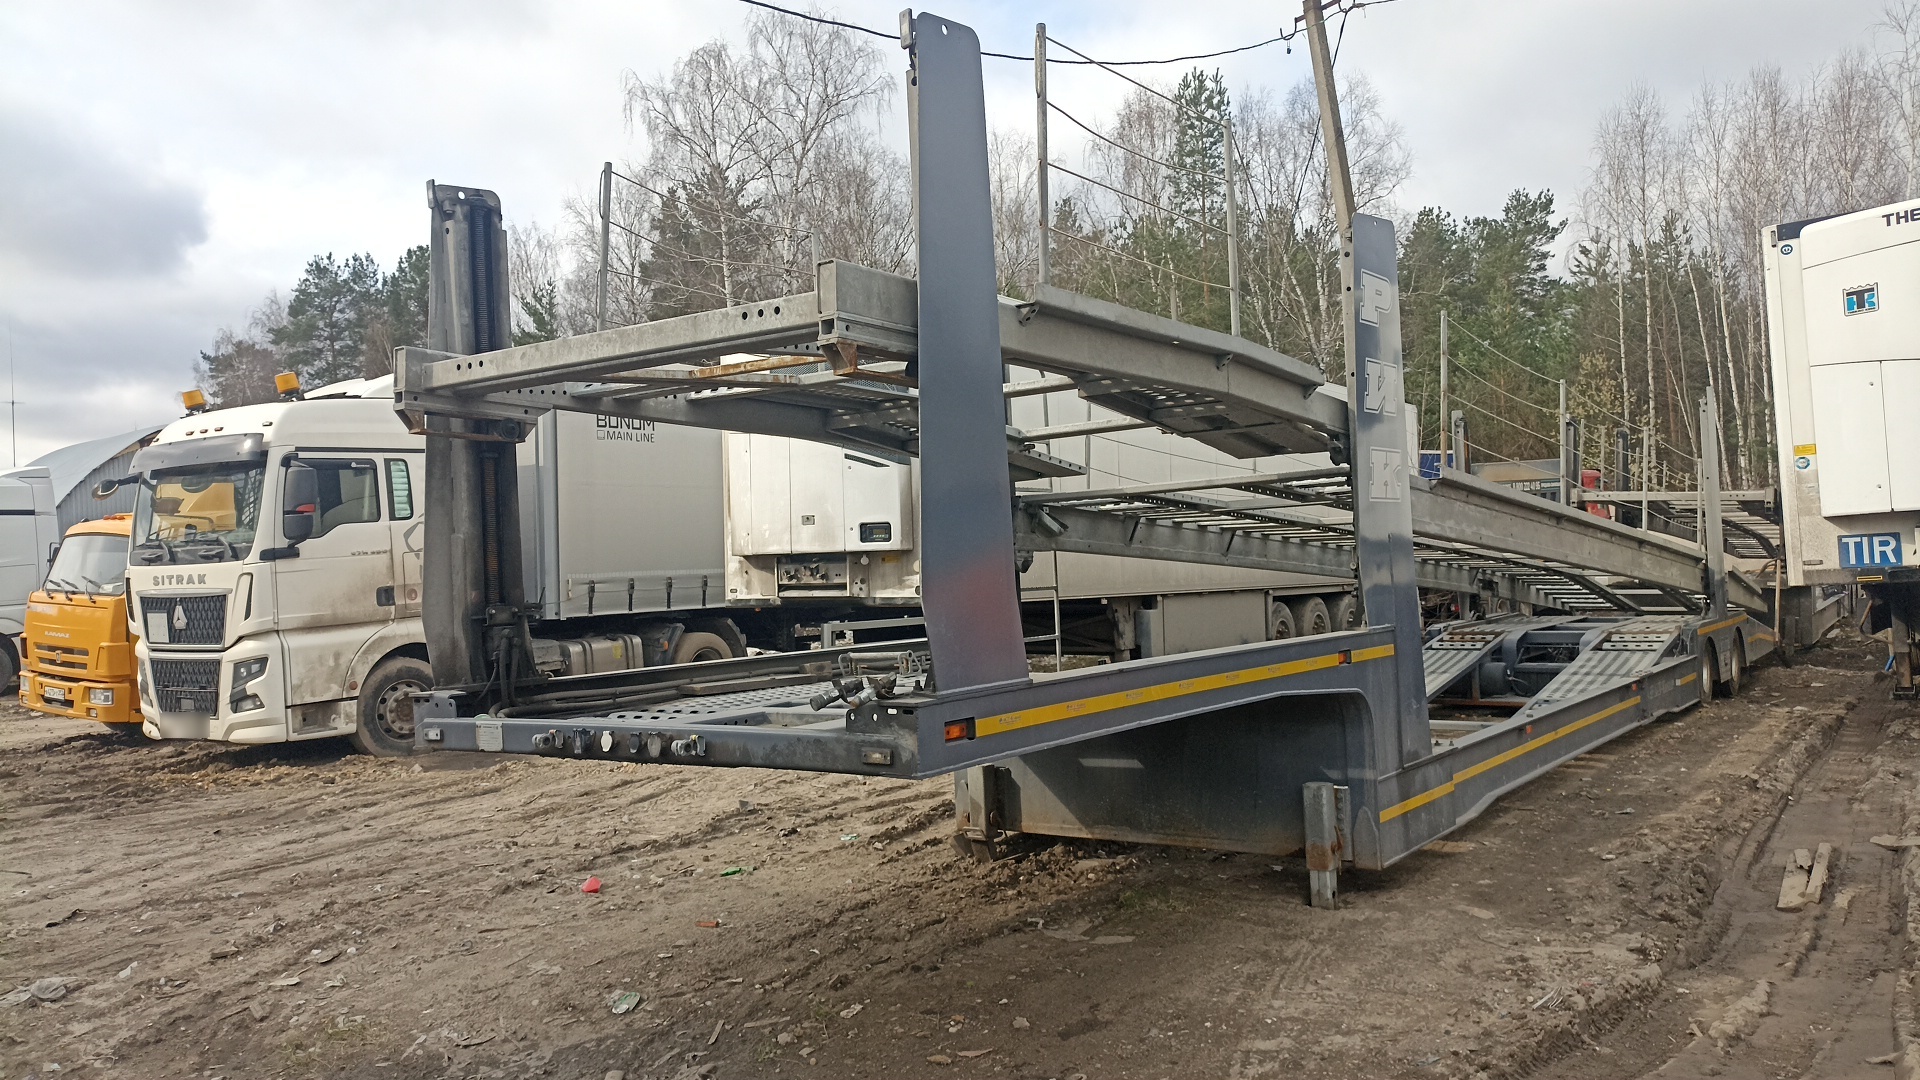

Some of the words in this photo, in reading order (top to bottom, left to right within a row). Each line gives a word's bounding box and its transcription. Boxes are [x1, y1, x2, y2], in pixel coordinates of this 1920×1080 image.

[606, 430, 633, 442] MAIN
[635, 431, 655, 443] LINE
[1841, 535, 1897, 565] TIR
[152, 573, 207, 587] SITRAK
